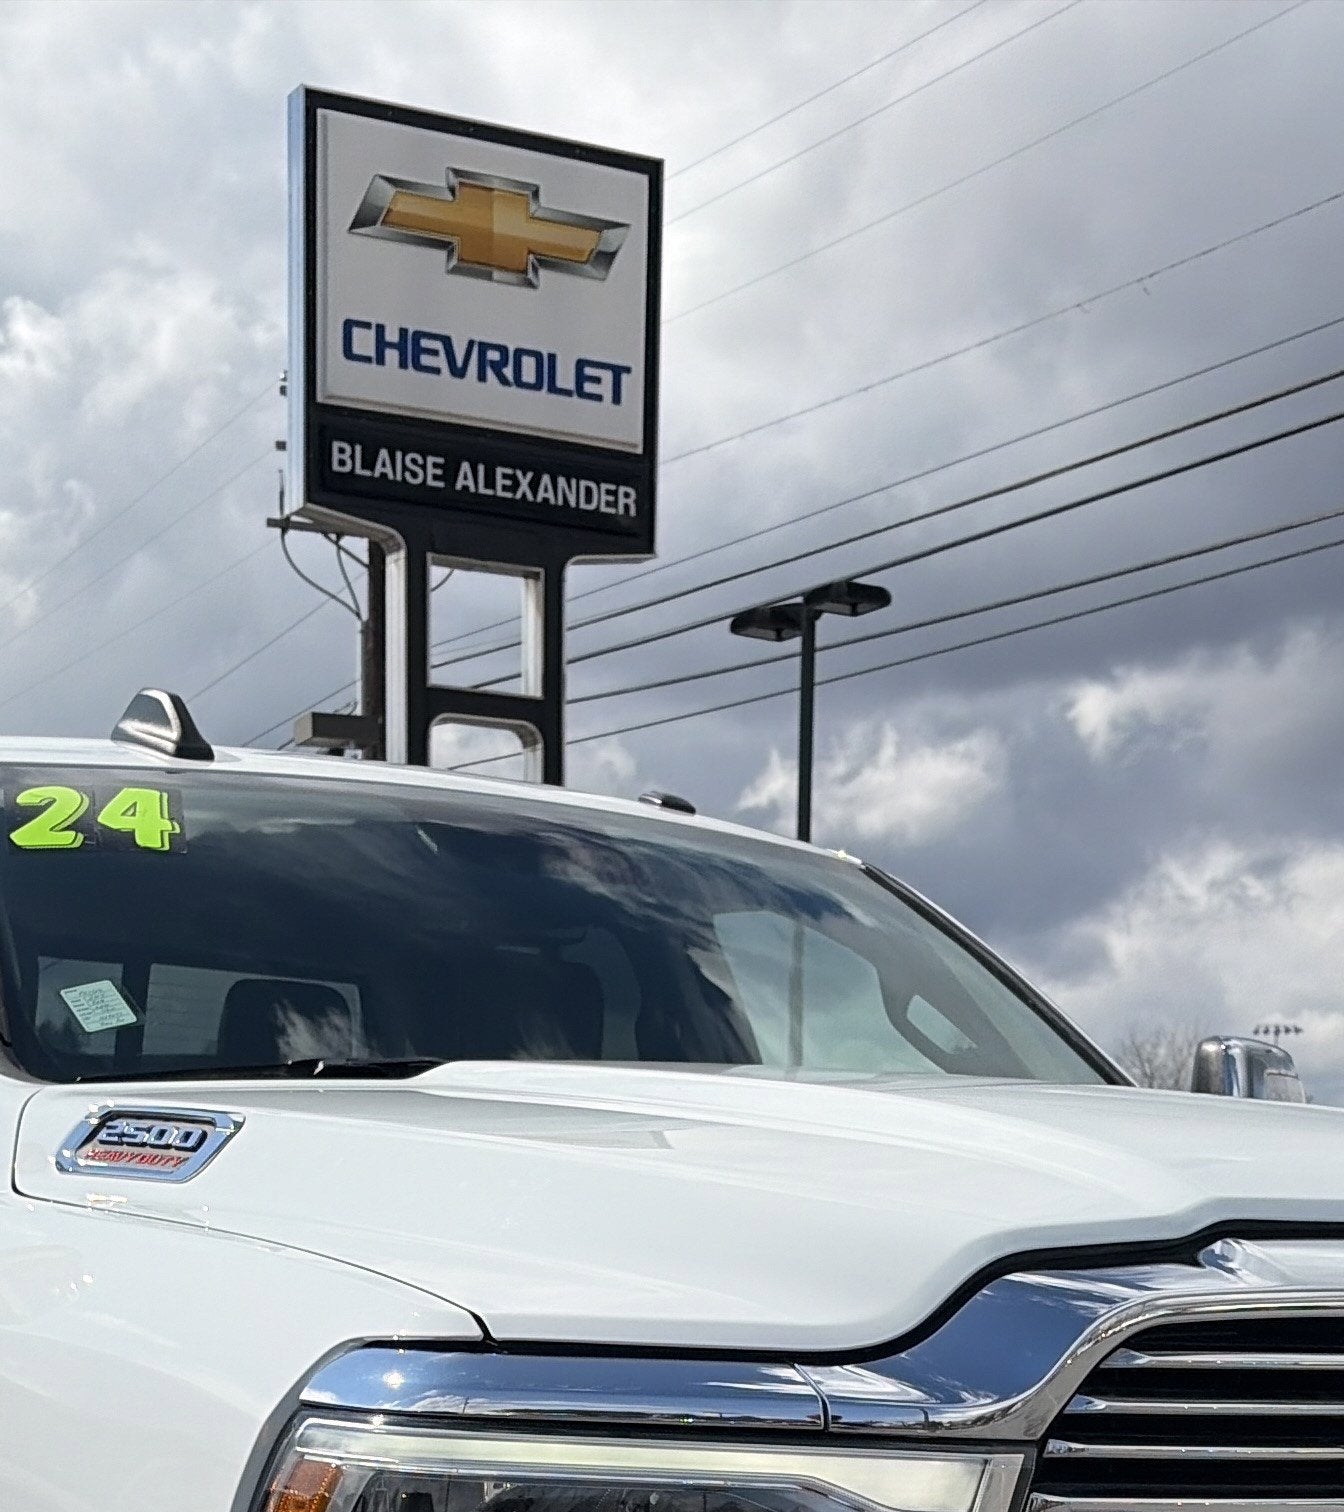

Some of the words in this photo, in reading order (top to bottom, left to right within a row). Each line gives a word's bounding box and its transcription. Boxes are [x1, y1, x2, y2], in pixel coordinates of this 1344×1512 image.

[342, 317, 632, 406] CHEVROLET
[331, 440, 446, 488] BLAISE
[455, 460, 637, 518] ALEXANDER
[9, 785, 180, 851] 24
[98, 1120, 207, 1151] 2500
